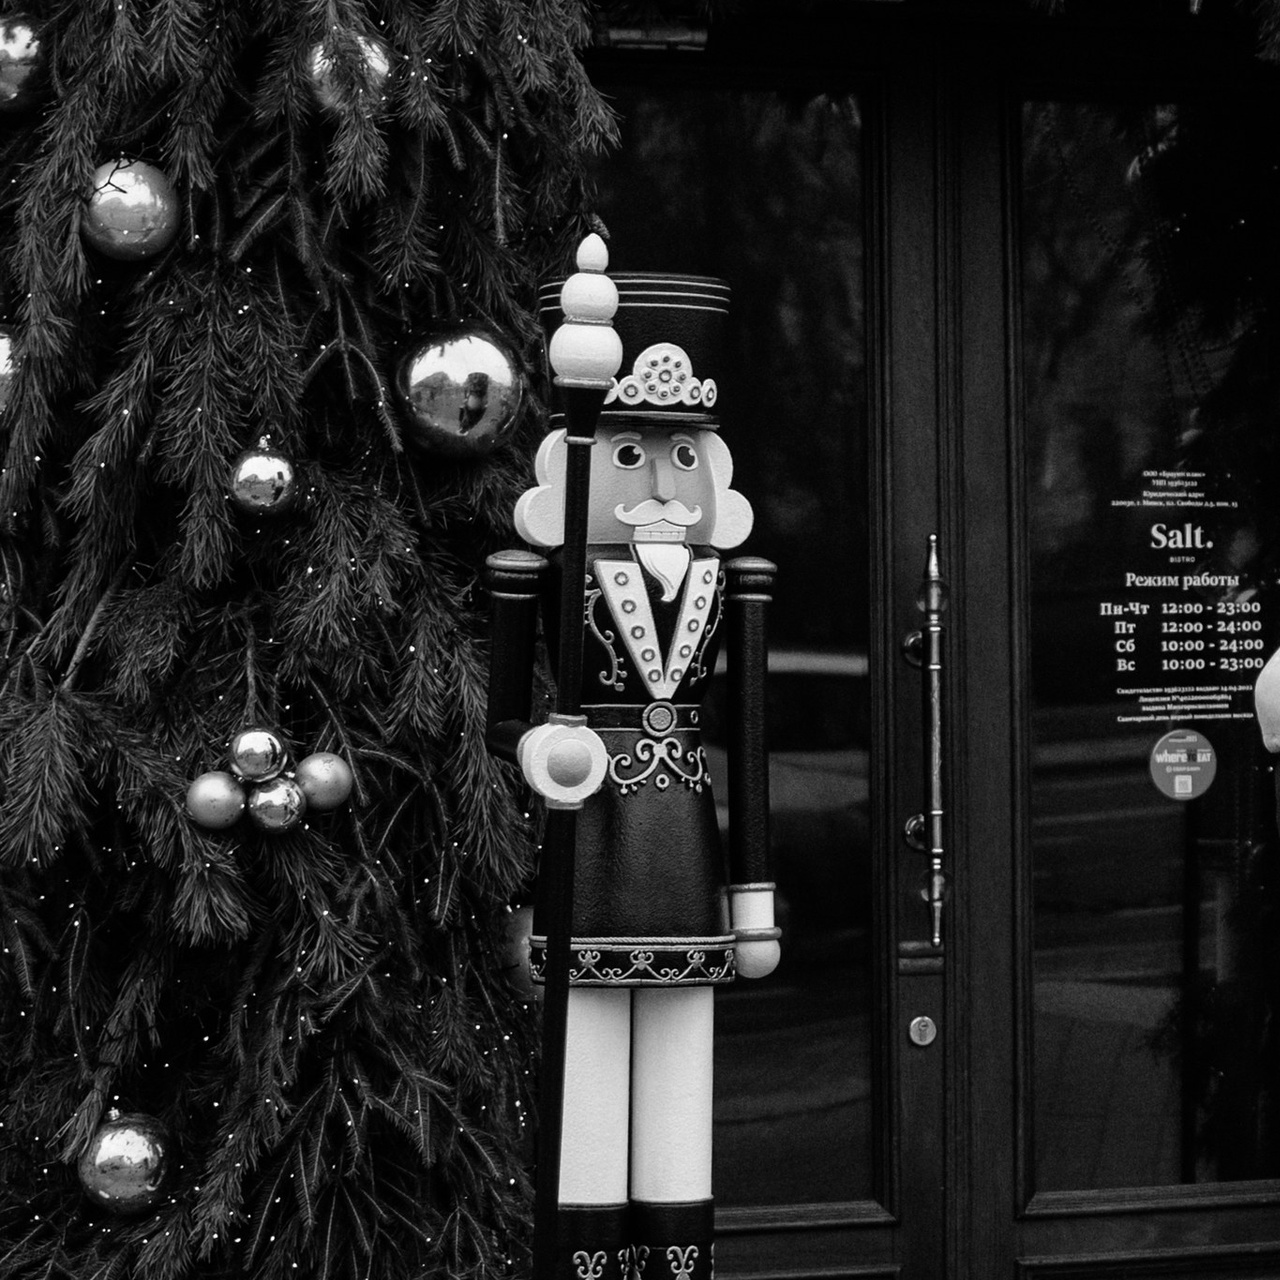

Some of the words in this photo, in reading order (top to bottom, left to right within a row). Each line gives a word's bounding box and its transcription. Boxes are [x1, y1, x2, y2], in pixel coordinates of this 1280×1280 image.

[1150, 522, 1214, 549] Salt.
[1169, 555, 1196, 563] BISTRO
[1125, 572, 1180, 587] Режим
[1182, 572, 1240, 591] работы
[1100, 601, 1150, 616] Пн-Чт
[1161, 602, 1204, 614] 12:00
[1216, 601, 1261, 616] 23:00
[1114, 620, 1137, 634] Пт
[1161, 621, 1204, 633] 12:00
[1216, 620, 1262, 634] 24:00
[1115, 638, 1136, 653] Сб
[1161, 639, 1205, 652] 10:00
[1219, 638, 1264, 653] 24:00
[1116, 658, 1136, 671] Вс
[1162, 658, 1206, 671] 10:00
[1219, 657, 1264, 671] 23:00
